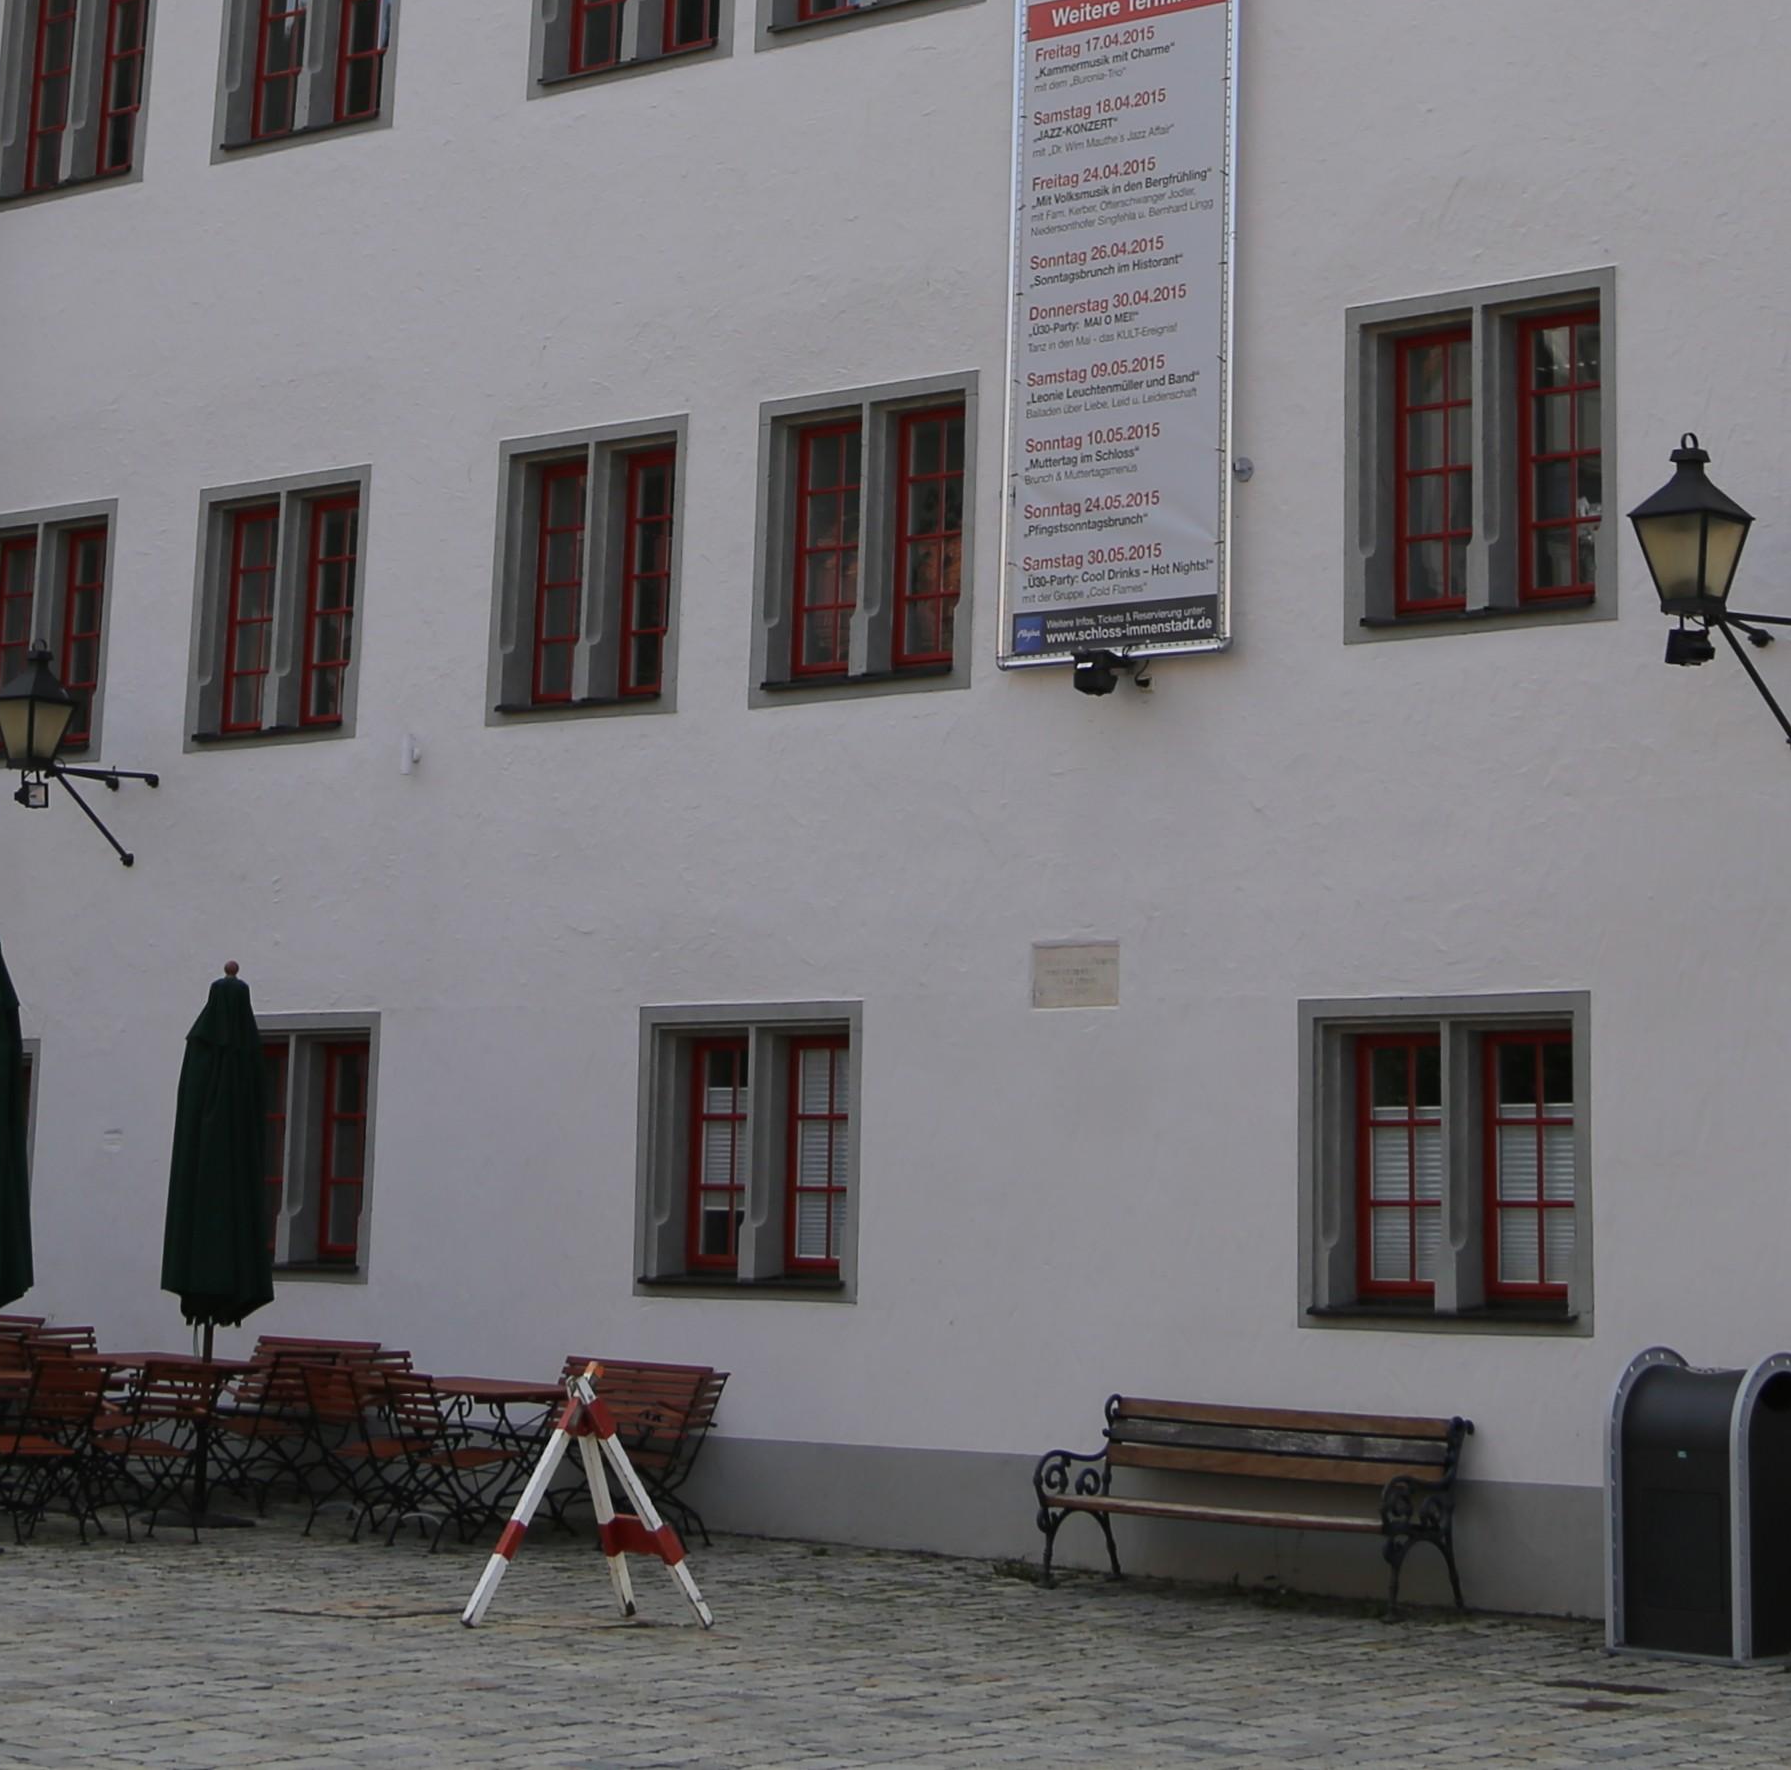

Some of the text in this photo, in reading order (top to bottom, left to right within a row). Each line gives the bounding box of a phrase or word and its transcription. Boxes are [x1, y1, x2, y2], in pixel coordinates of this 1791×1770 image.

[1035, 25, 1154, 62] Freitag 17.04.2015
[1112, 50, 1127, 63] mit
[1033, 88, 1165, 125] Samstag 18.04.2015
[1032, 156, 1155, 191] Freitag 24.04.2015
[1054, 184, 1109, 204] Volksmusik
[1112, 182, 1121, 194] in
[1123, 178, 1142, 192] den
[1030, 235, 1163, 270] Sonntag 26.04.2015
[1117, 261, 1129, 273] im
[1028, 283, 1186, 321] Donnerstag 30.04.2015
[1083, 316, 1101, 328] MAI
[1026, 354, 1165, 388] Samstag 09.05.2015
[1066, 377, 1143, 399] Leuchtenmüller
[1146, 374, 1165, 388] und
[1025, 422, 1160, 453] Sonntag 10.05.2015
[1080, 452, 1092, 463] im
[1023, 489, 1159, 519] Sonntag 24.05.2015
[1022, 542, 1162, 571] Samstag 30.05.2015
[1081, 570, 1104, 582] Cool
[1107, 566, 1140, 580] Drinks
[1151, 563, 1169, 576] Hot
[1046, 616, 1212, 643] www.schloss-immenstadt.de
